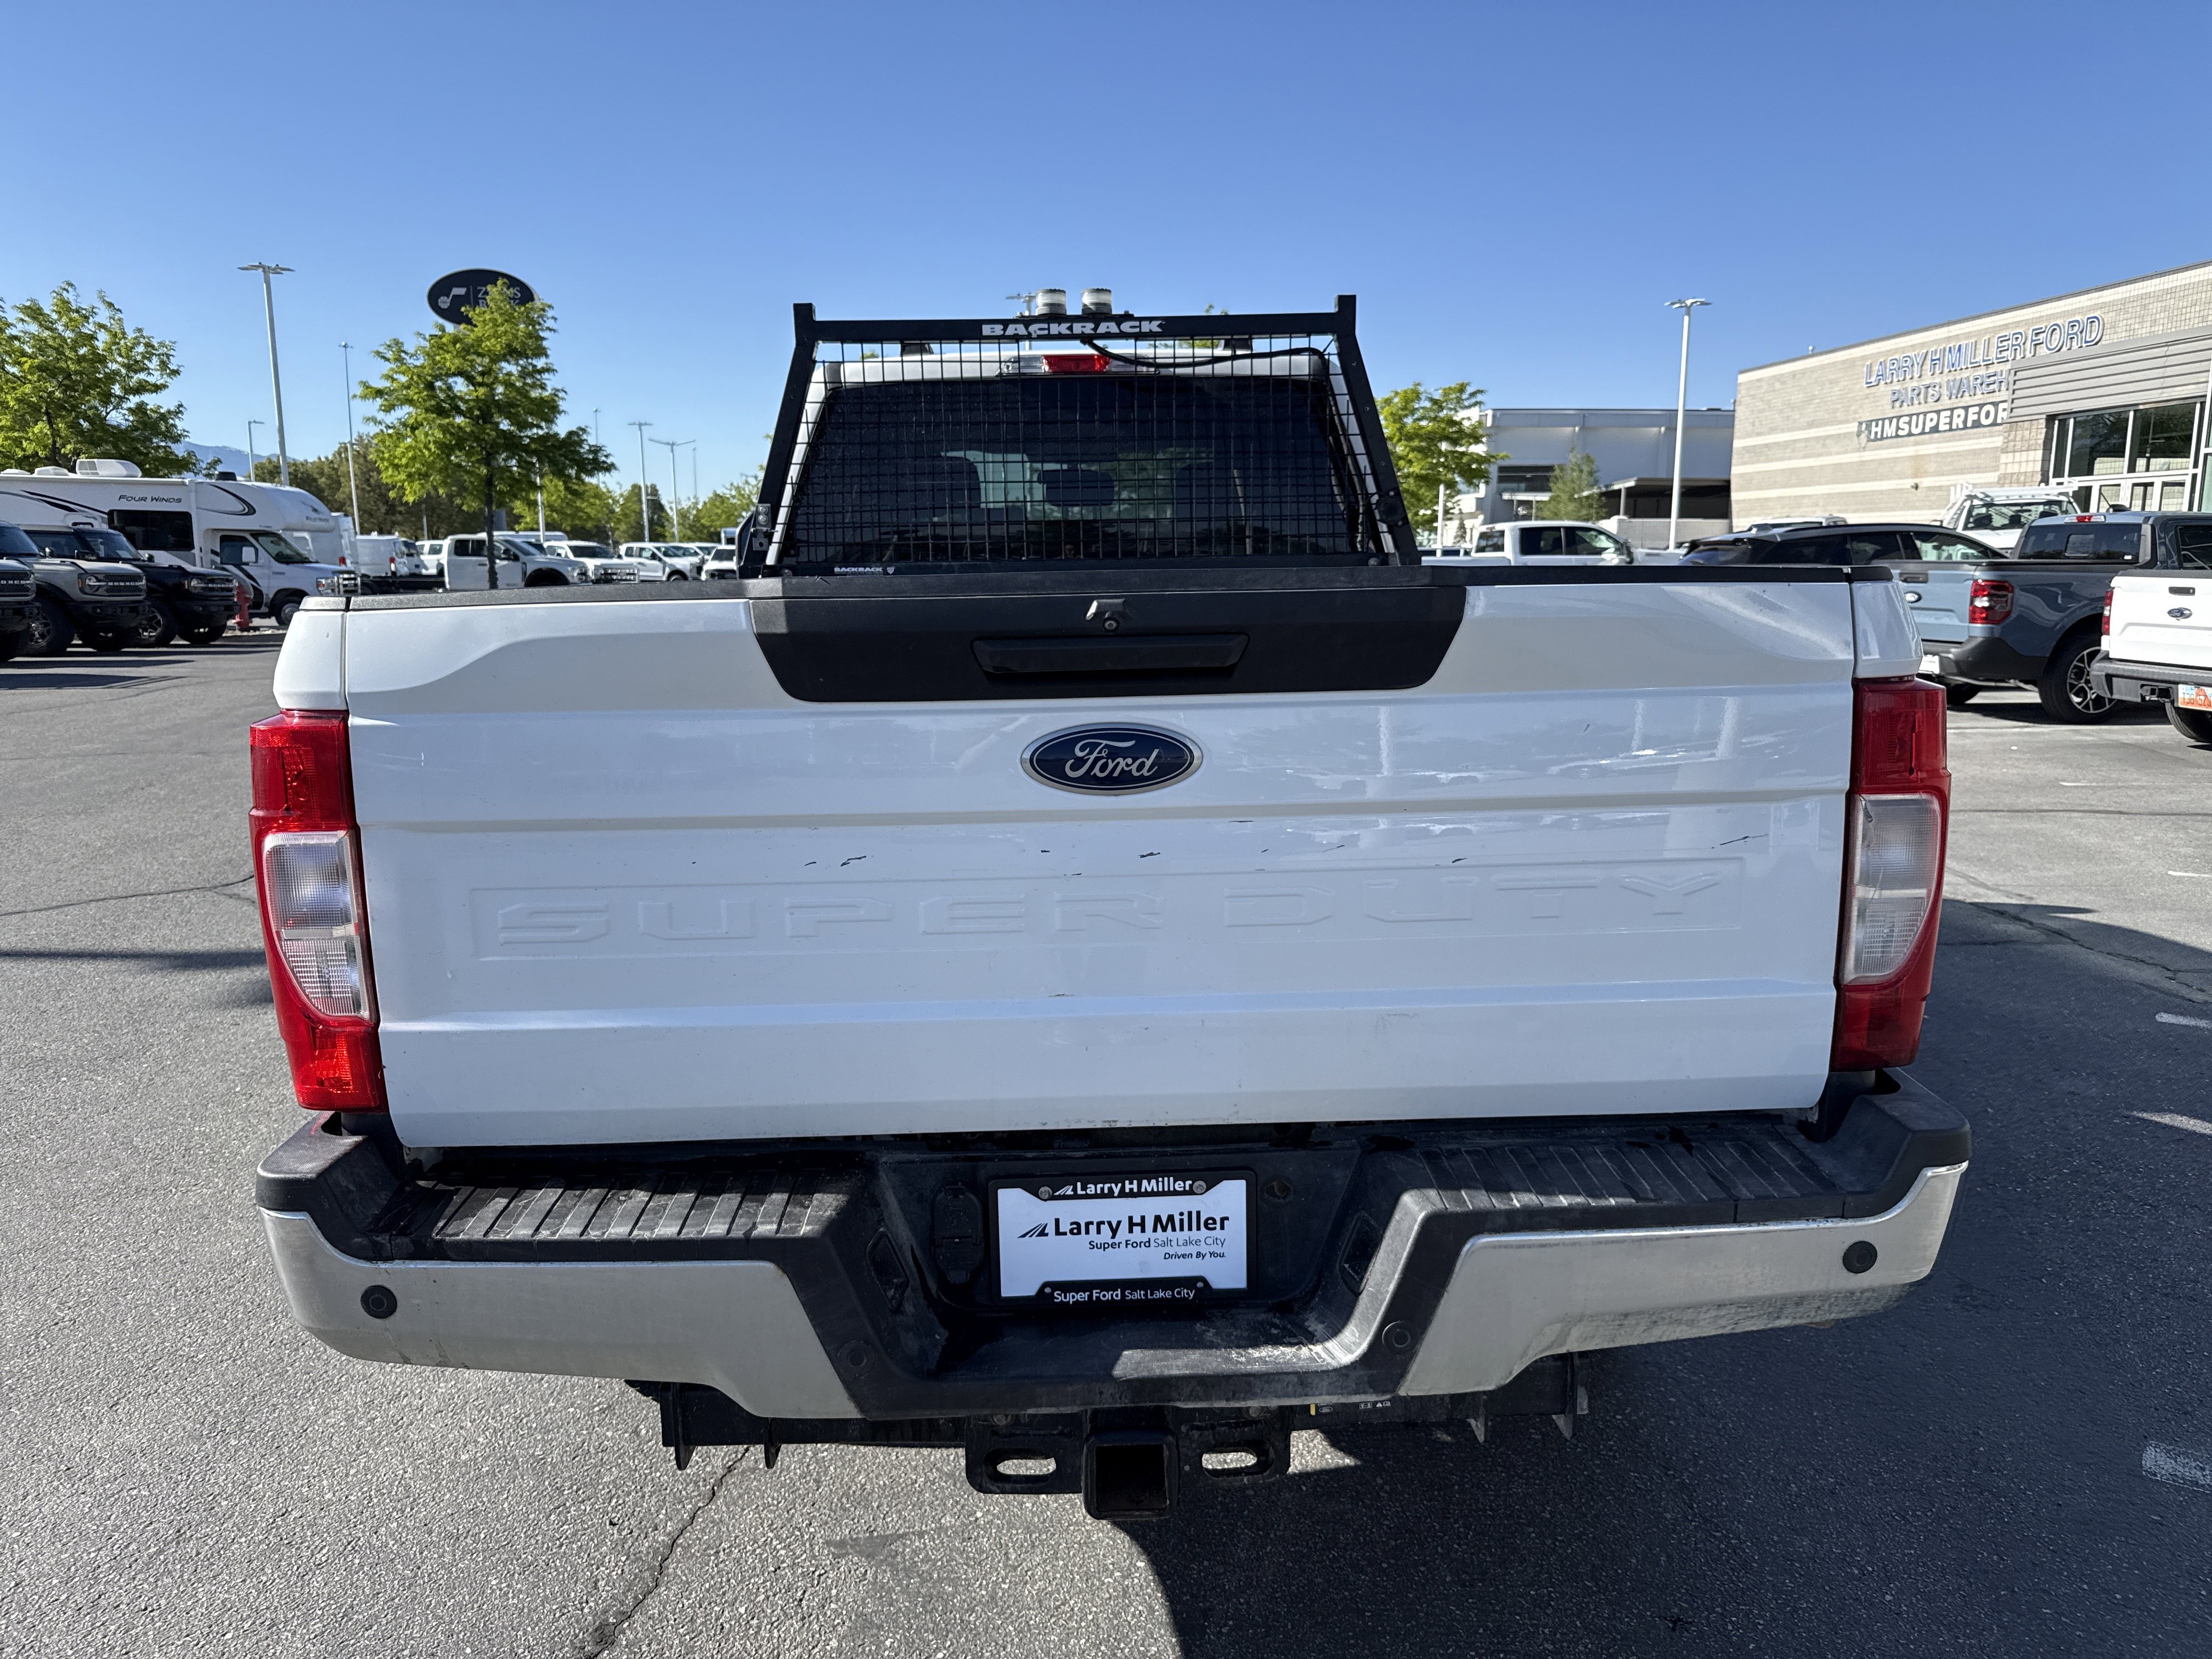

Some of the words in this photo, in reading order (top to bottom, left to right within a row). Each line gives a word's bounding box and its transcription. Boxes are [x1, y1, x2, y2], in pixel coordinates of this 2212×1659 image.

[981, 320, 1164, 338] BACKRACK
[1864, 350, 1927, 387] LARRY
[1929, 345, 1943, 375] H
[1945, 330, 2026, 372] MILLER
[2029, 314, 2104, 358] FORD
[1889, 382, 1941, 409] PARTS
[1945, 369, 2009, 399] WAREH
[1065, 739, 1158, 778] Ford
[498, 891, 1163, 944] SUPER
[1222, 871, 1722, 928] DUTY
[1076, 1181, 1121, 1197] Larry
[1125, 1180, 1138, 1193] H
[1141, 1176, 1192, 1192] Miller
[1054, 1216, 1122, 1239] Larry
[1127, 1215, 1146, 1234] H
[1152, 1210, 1229, 1233] Miller
[1088, 1239, 1122, 1251] Super
[1125, 1238, 1151, 1248] Ford
[1154, 1237, 1173, 1248] Salt
[1176, 1235, 1201, 1247] Lake
[1204, 1235, 1226, 1248] City
[1195, 1251, 1206, 1260] By
[1054, 1290, 1090, 1304] Super
[1093, 1288, 1121, 1300] Ford
[1125, 1289, 1145, 1300] Salt
[1148, 1288, 1172, 1299] Lake
[1174, 1288, 1195, 1299] City
